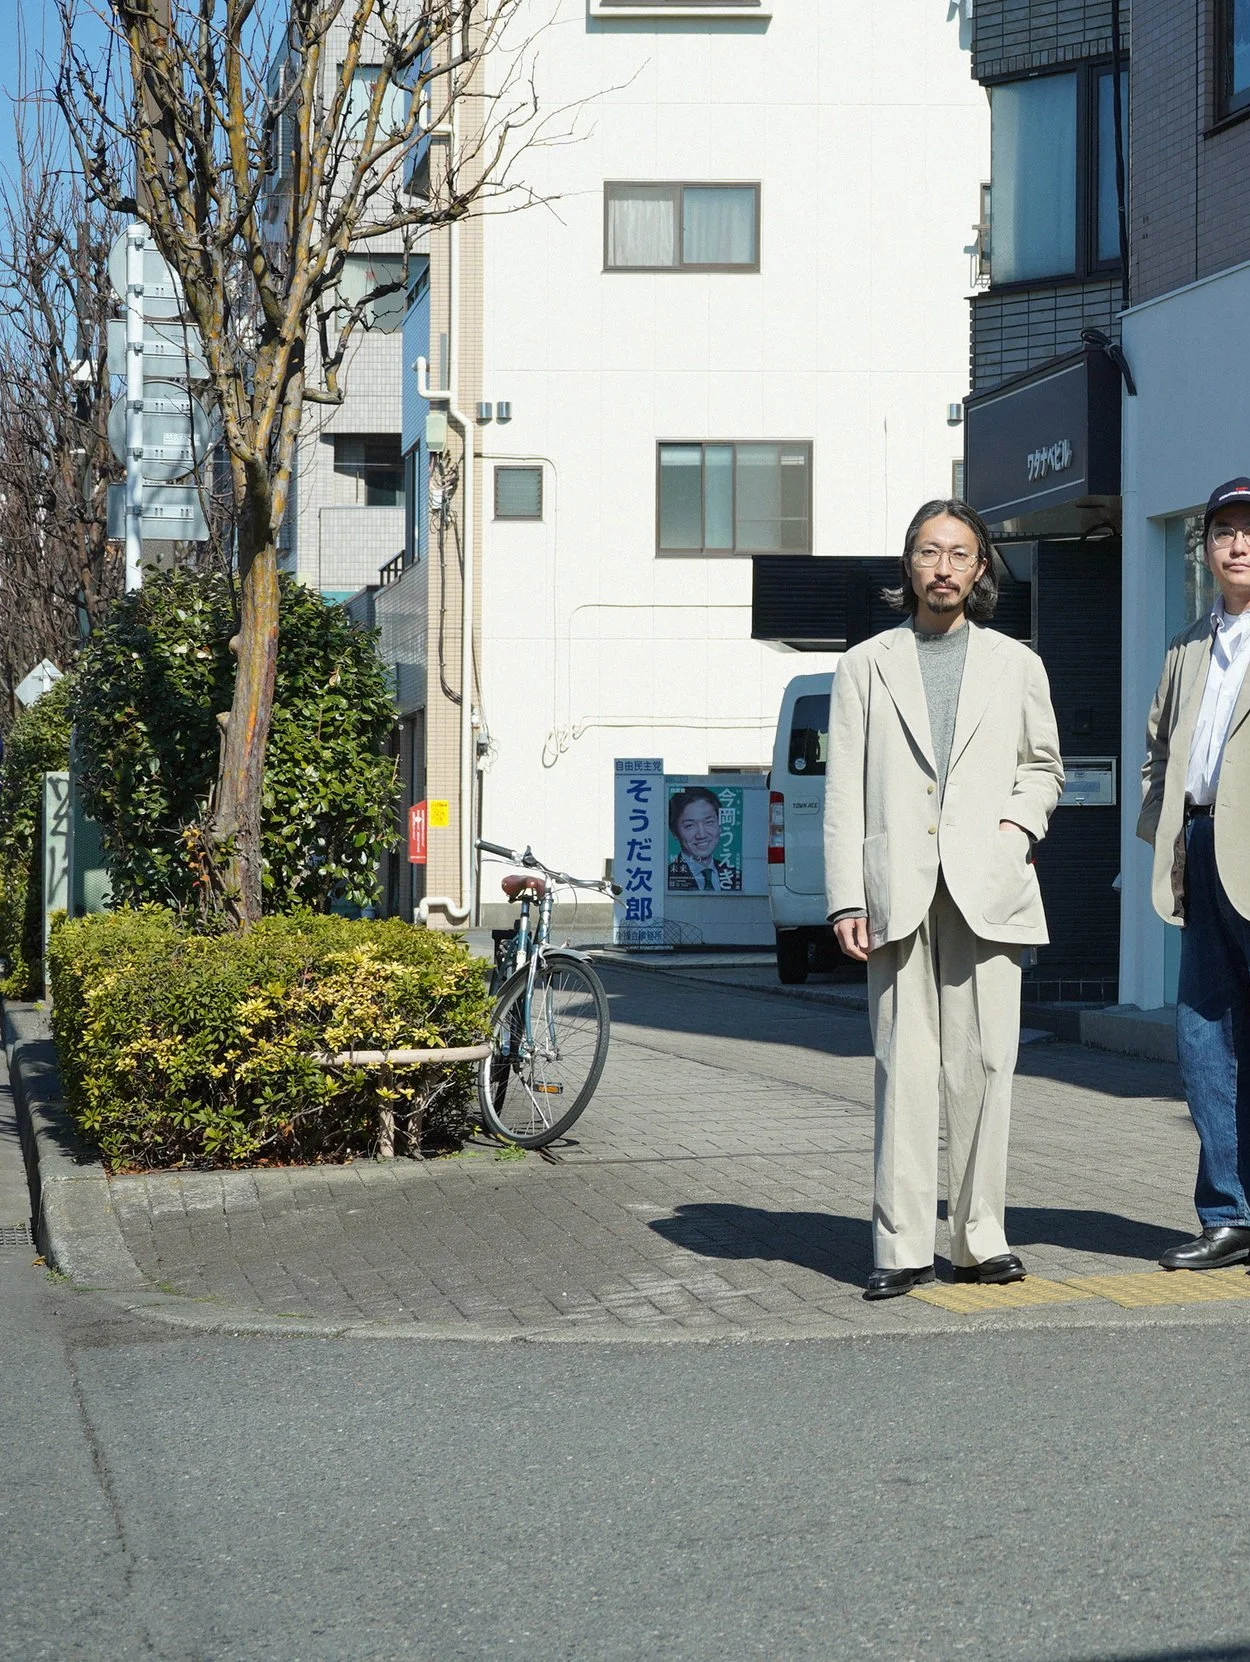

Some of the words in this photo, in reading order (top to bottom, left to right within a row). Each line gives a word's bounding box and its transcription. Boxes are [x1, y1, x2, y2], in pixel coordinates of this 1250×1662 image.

[1027, 439, 1073, 481] ワタナベビル
[615, 760, 662, 772] 自由民主党
[625, 779, 653, 922] そうだ次郎
[718, 788, 737, 890] 今岡うえき
